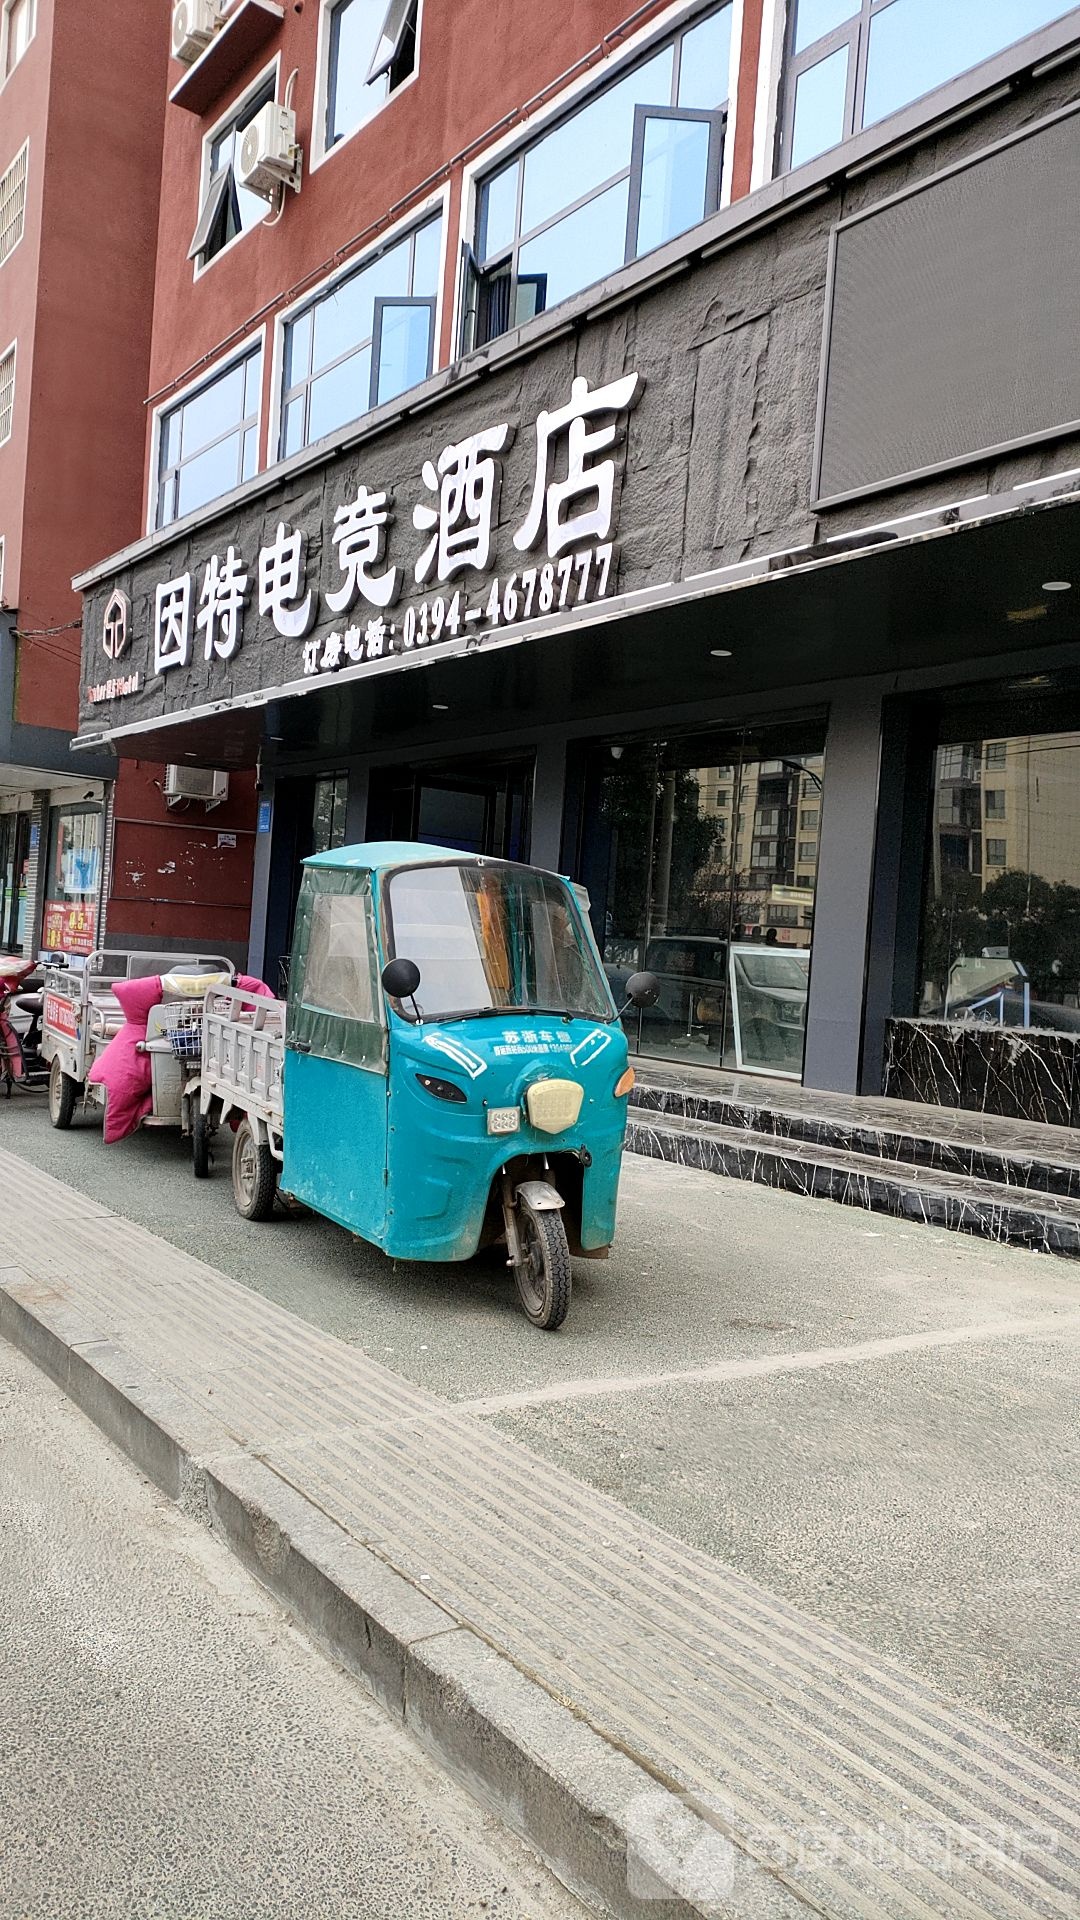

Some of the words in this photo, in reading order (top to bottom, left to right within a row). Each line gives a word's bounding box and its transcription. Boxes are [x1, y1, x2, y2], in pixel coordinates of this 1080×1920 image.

[154, 371, 639, 674] 因特电竞酒店
